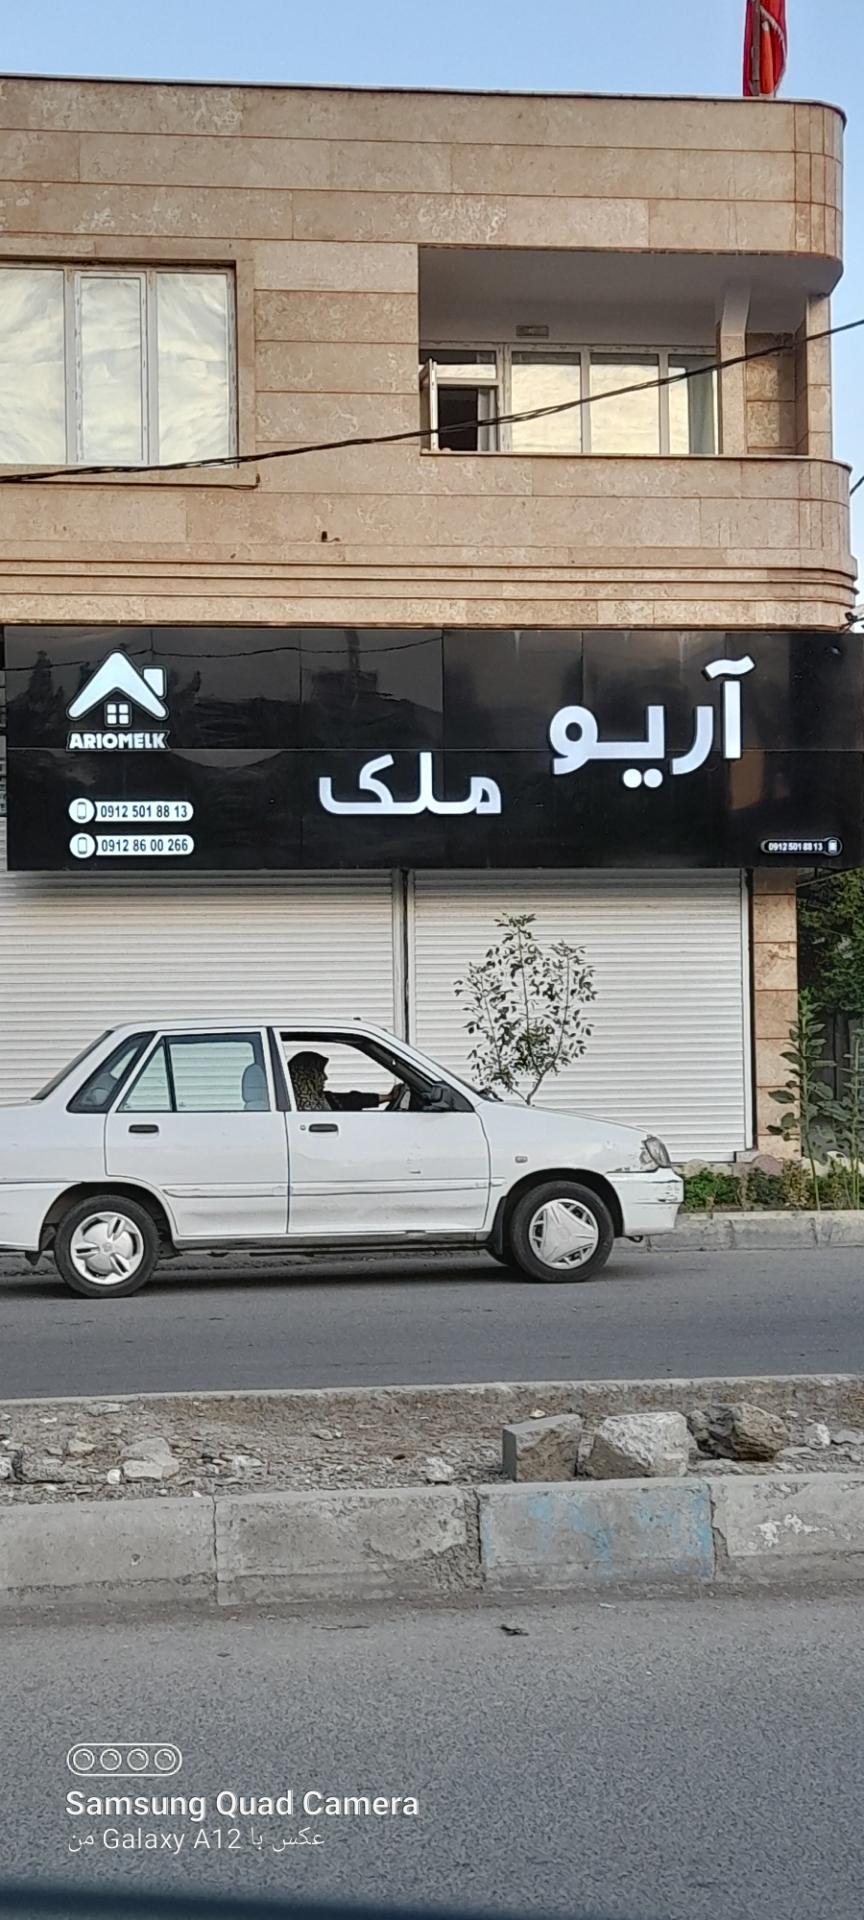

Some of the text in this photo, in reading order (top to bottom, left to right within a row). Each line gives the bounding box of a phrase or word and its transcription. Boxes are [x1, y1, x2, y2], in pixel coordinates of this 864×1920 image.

[549, 655, 756, 789] آریو
[69, 732, 166, 749] ARIOMELK
[318, 751, 502, 815] ملک
[100, 804, 188, 819] 0912 501 88 13
[101, 838, 189, 853] 0912 86 00 266
[768, 842, 788, 851] 0912
[788, 842, 802, 851] 501
[813, 842, 823, 851] 13
